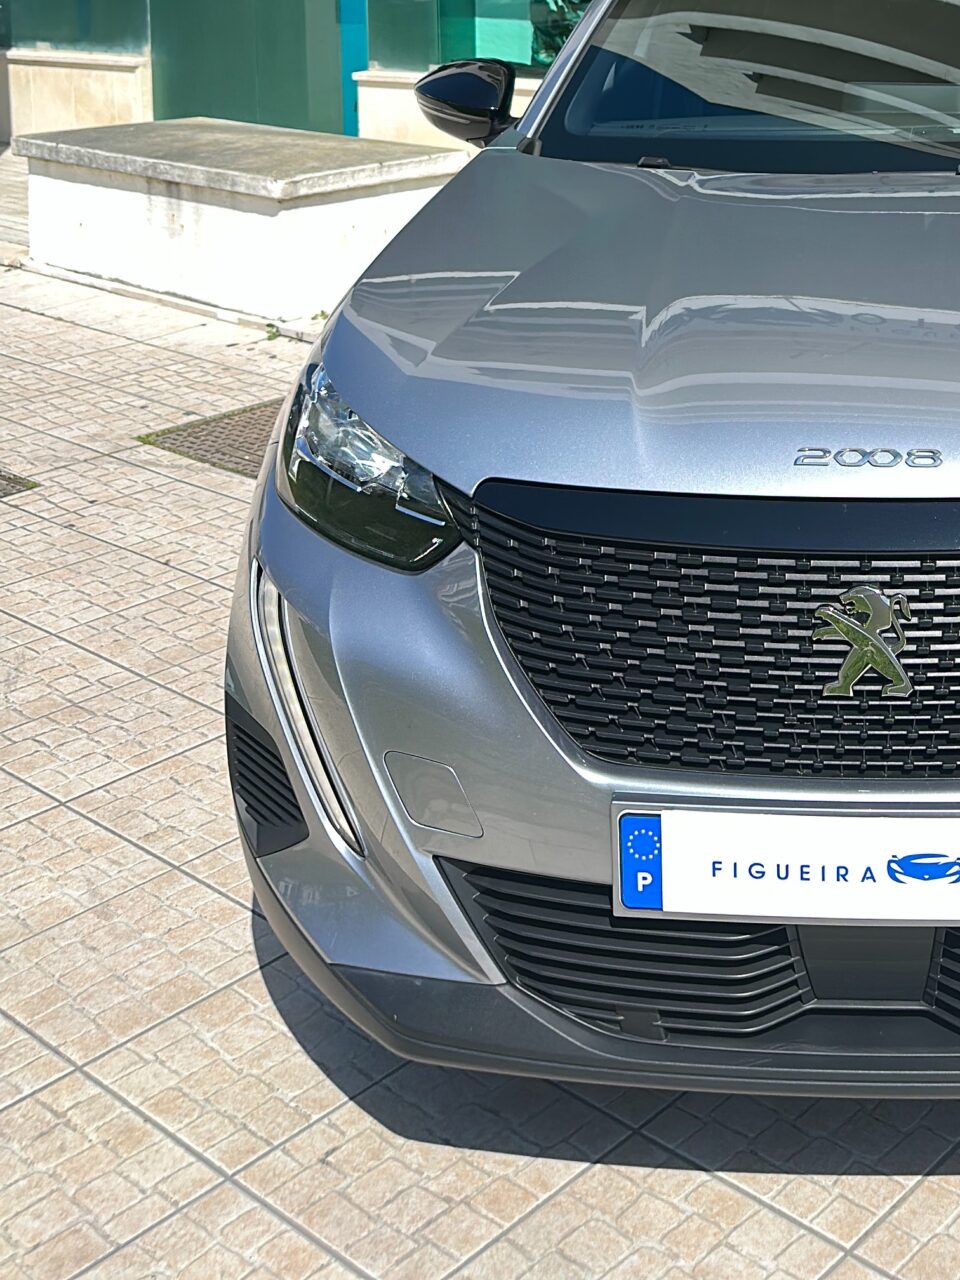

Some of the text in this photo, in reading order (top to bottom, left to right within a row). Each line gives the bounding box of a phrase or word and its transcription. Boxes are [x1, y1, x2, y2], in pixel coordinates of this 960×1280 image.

[793, 447, 944, 468] 2008
[712, 860, 877, 883] FIGUEIRA
[636, 872, 653, 893] P
